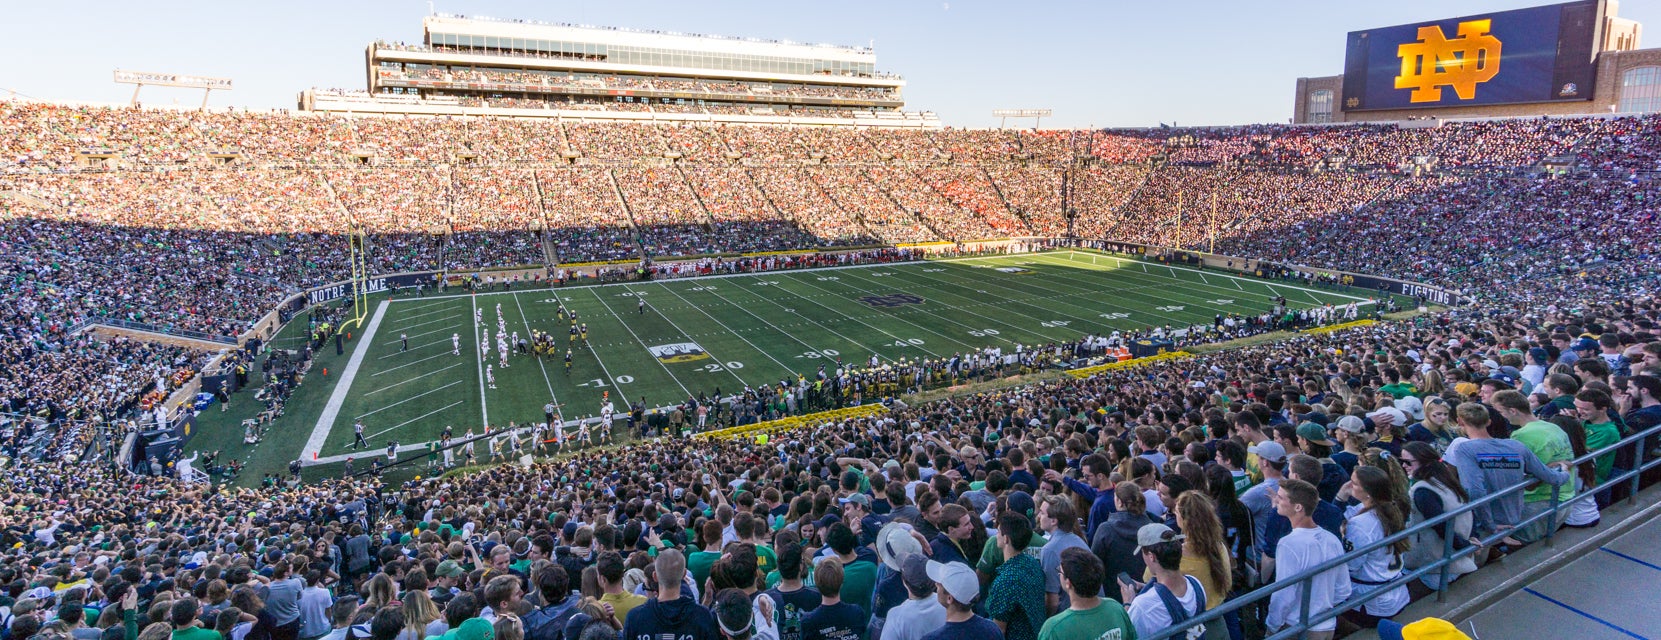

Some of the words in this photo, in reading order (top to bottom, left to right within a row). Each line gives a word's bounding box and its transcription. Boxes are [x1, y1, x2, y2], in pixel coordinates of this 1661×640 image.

[311, 285, 345, 304] NOTRE
[1402, 283, 1450, 305] FIGHTING
[968, 328, 1000, 337] 50
[894, 338, 925, 347] 40
[803, 349, 840, 359] 30
[704, 361, 744, 373] 20
[590, 375, 634, 388] 10
